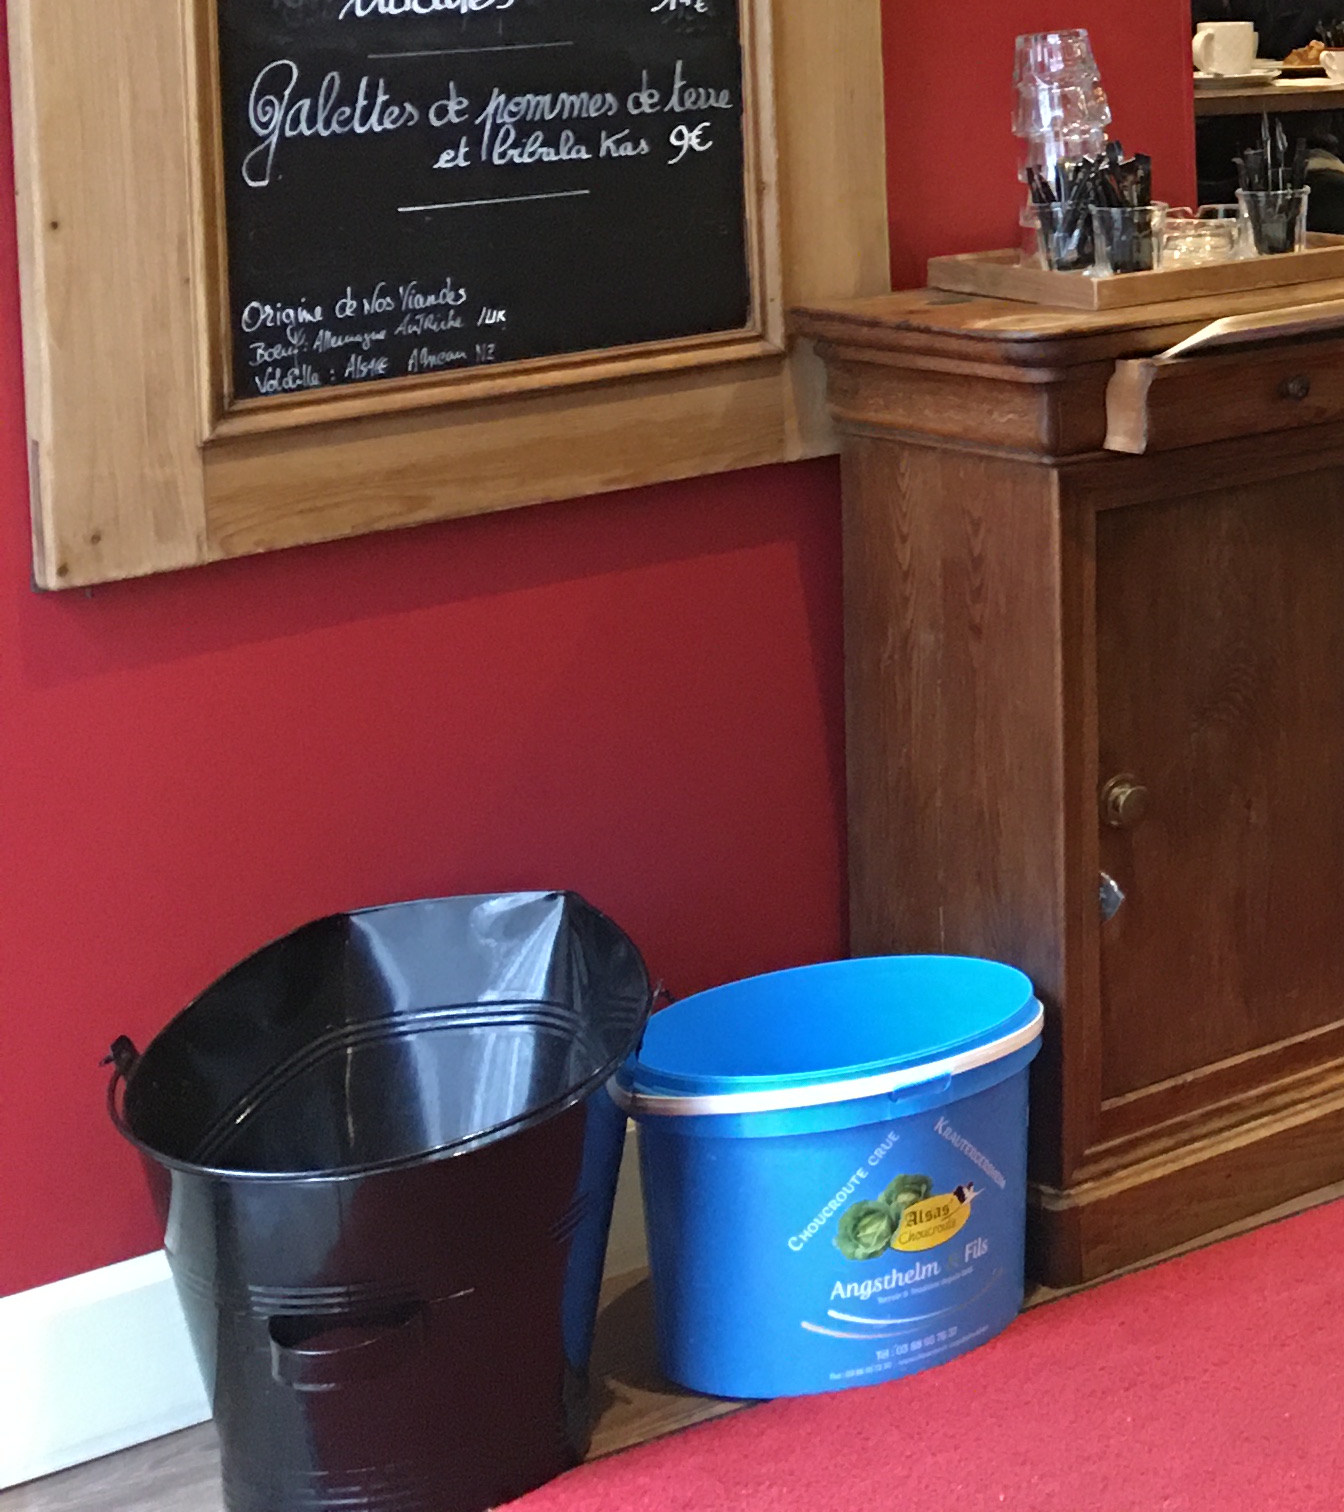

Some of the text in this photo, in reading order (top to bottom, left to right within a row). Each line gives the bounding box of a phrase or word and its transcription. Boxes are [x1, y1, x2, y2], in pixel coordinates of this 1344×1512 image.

[241, 58, 734, 187] Galettes de pommes de terre
[432, 136, 472, 170] et
[667, 121, 713, 165] 9€
[241, 276, 468, 345] Origine de Nos Viandes
[829, 1259, 942, 1302] Angsthelm
[964, 1236, 990, 1264] Fils
